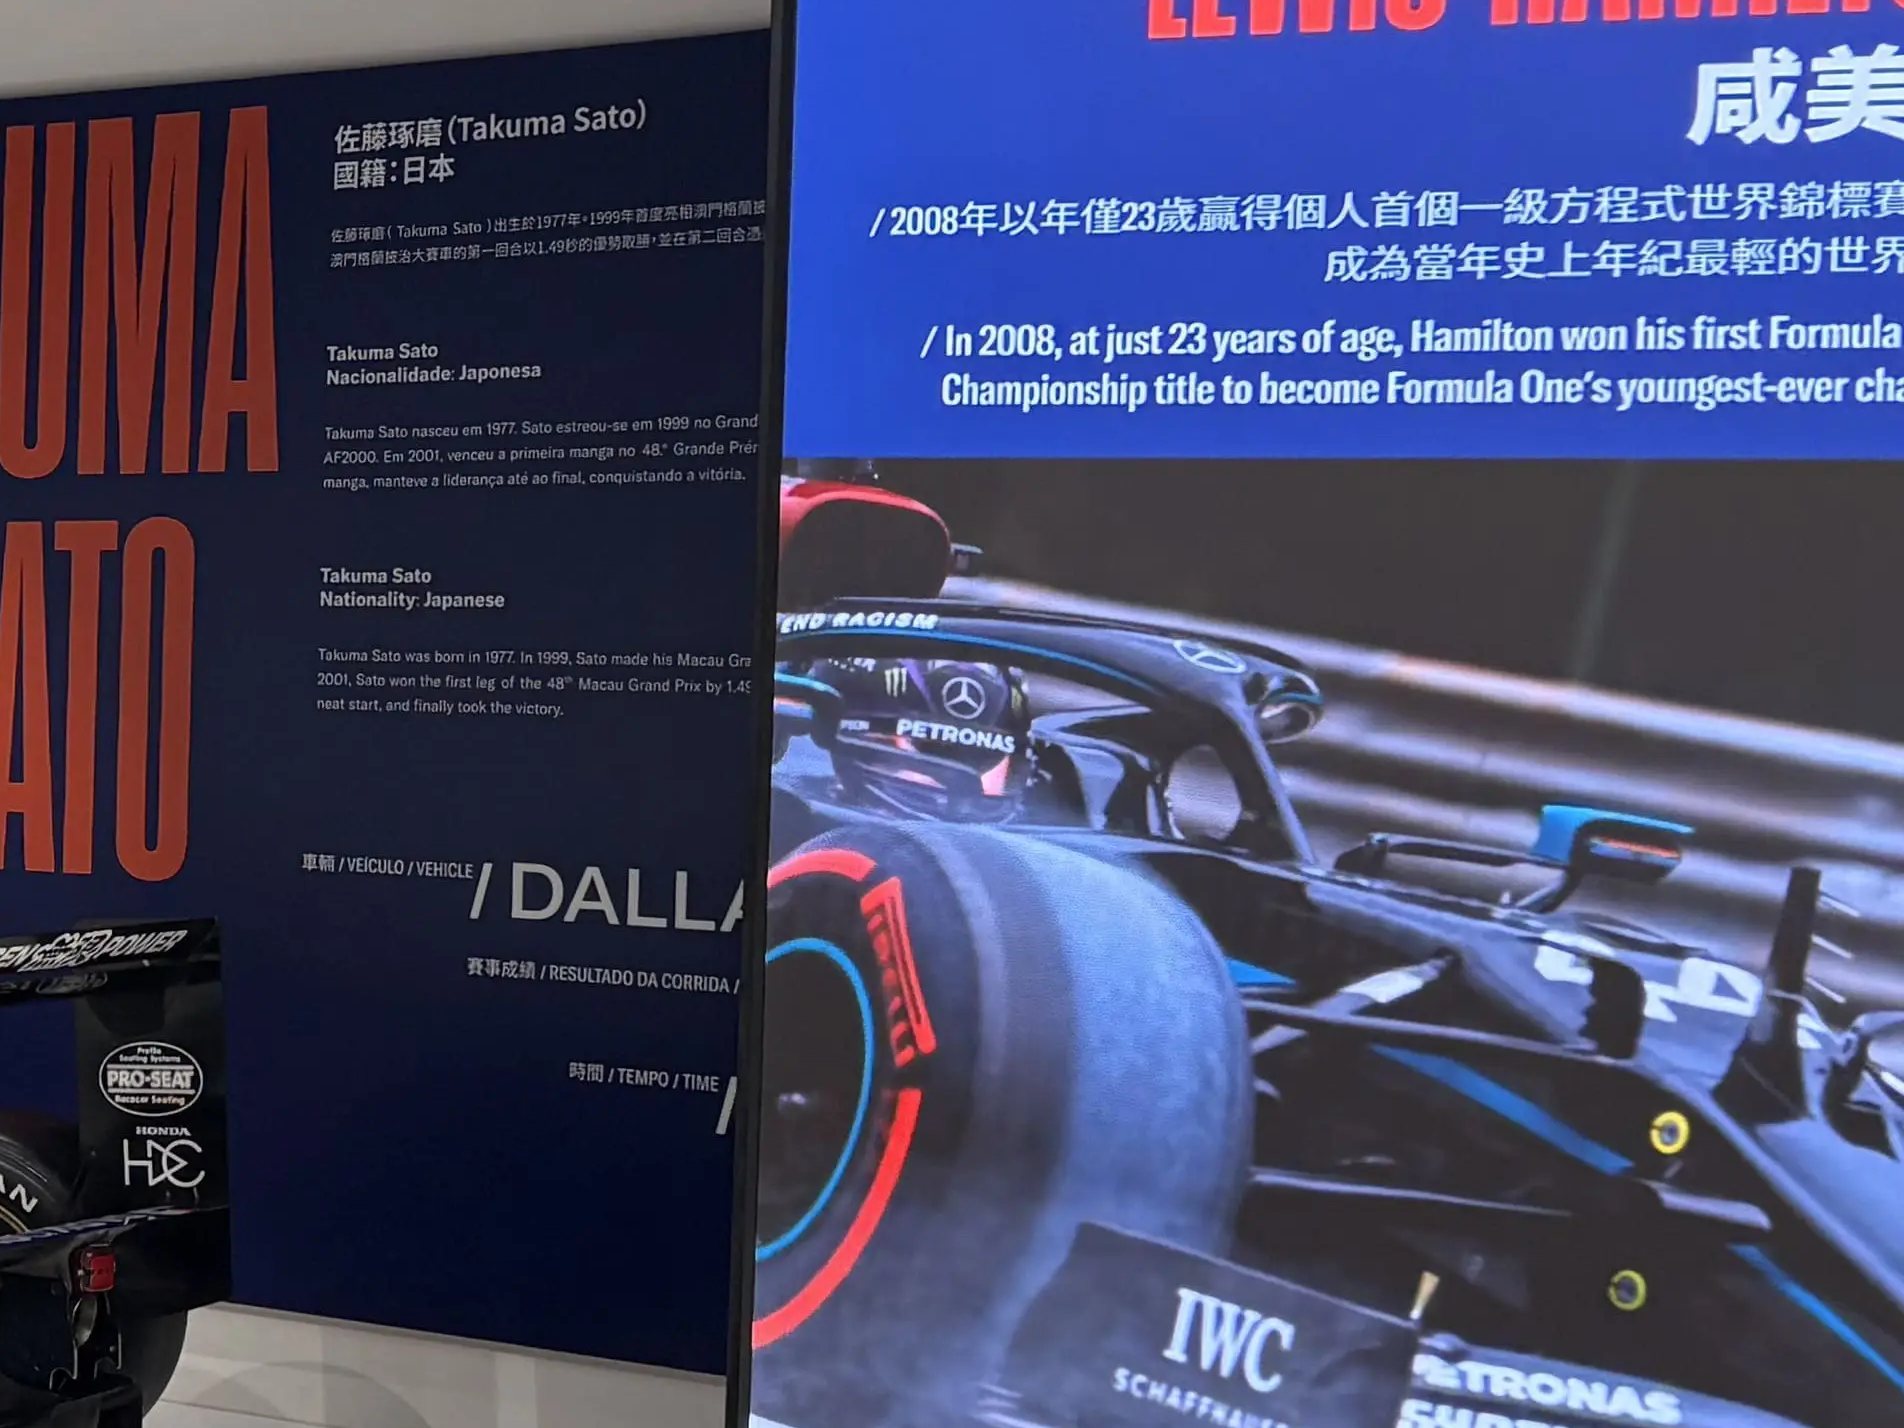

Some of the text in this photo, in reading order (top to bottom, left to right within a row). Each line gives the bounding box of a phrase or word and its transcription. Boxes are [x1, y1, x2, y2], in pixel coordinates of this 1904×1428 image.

[397, 220, 482, 239] Takuma Sato
[945, 313, 1902, 364] In 2008, at just 23 years of age, Hamilton won his first Formula
[326, 342, 439, 362] Takuma Sato
[326, 364, 541, 386] Nacionalidade: Japonesa
[941, 371, 1148, 413] Championship
[1153, 371, 1216, 405] title
[1221, 375, 1253, 405] to
[1259, 371, 1380, 405] become
[1386, 369, 1514, 405] Formula
[1520, 368, 1612, 404] One's
[1615, 371, 1851, 412] youngest-ever
[324, 413, 759, 440] Takuma Sato nasceu em 1977. Sato estreou-se em 1999 no Grand
[319, 567, 432, 584] Takuma Sato
[320, 590, 505, 611] Nationality: Japanese
[317, 647, 368, 662] Takuma
[371, 648, 402, 662] Sato
[404, 652, 431, 663] was
[434, 650, 465, 663] born
[468, 652, 481, 663] in
[485, 650, 516, 665] 1977.
[520, 651, 533, 664] In
[537, 651, 573, 666] 1999,
[575, 651, 608, 666] Sato
[611, 652, 649, 666] made
[652, 652, 673, 666] his
[677, 652, 724, 668] Macau
[316, 698, 564, 719] neat start, and finally took the victory.
[896, 719, 1016, 754] PETRONAS
[416, 861, 474, 880] VEHICLE
[94, 929, 188, 961] POWER
[549, 964, 633, 988] RESULTADO
[637, 971, 659, 989] DA
[661, 973, 731, 994] CORRIDA
[617, 1067, 669, 1089] TEMPO
[683, 1073, 721, 1093] TIME
[135, 1126, 192, 1137] HONDA
[1162, 1285, 1296, 1393] IWC
